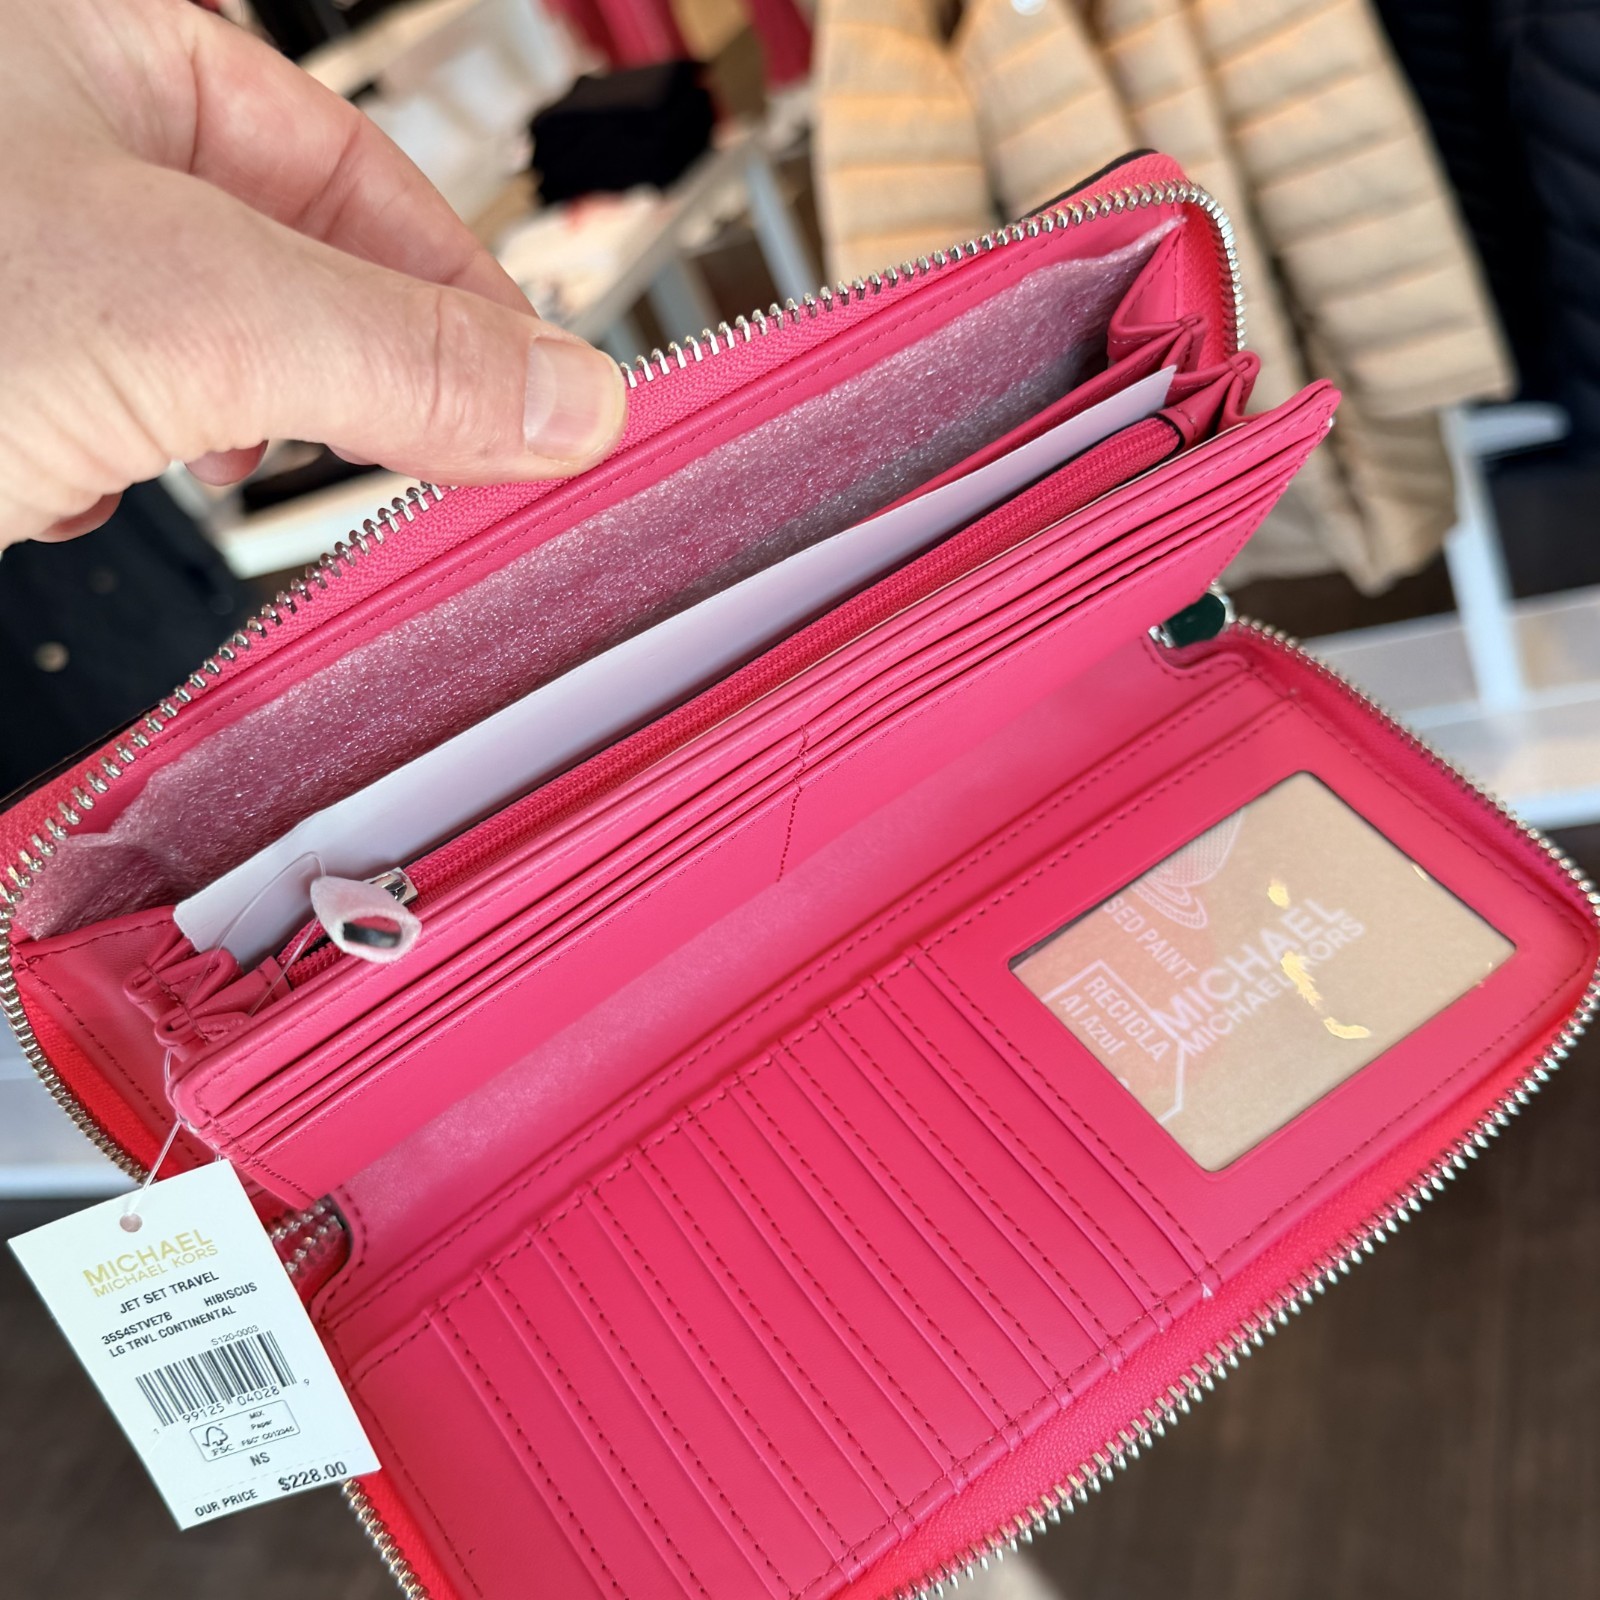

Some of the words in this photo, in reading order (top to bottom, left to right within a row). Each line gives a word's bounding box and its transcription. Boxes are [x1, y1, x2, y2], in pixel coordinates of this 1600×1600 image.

[1136, 928, 1198, 981] PAINT
[1150, 898, 1345, 1039] MICHAEL
[1084, 975, 1170, 1062] RECICLA
[1181, 971, 1294, 1057] MICHAEL
[82, 1229, 213, 1287] MICHAEL
[93, 1263, 168, 1297] MICHAEL
[171, 1244, 218, 1268] KORS
[101, 1311, 173, 1345] 35S4STVE7B
[203, 1282, 258, 1307] HIBISCUS
[120, 1297, 141, 1314] JET
[143, 1287, 167, 1304] SET
[169, 1271, 220, 1295] TRAVEL
[108, 1345, 126, 1358] LG
[126, 1333, 157, 1351] TRVL
[158, 1305, 237, 1339] CONTINENTAL
[211, 1324, 259, 1346] S120-0003
[182, 1403, 225, 1424] 99125
[236, 1386, 280, 1406] 04028
[303, 1378, 310, 1386] 9
[249, 1451, 271, 1467] NS
[194, 1502, 221, 1517] OUR
[222, 1488, 258, 1508] PRICE
[277, 1460, 348, 1491] $228.00
